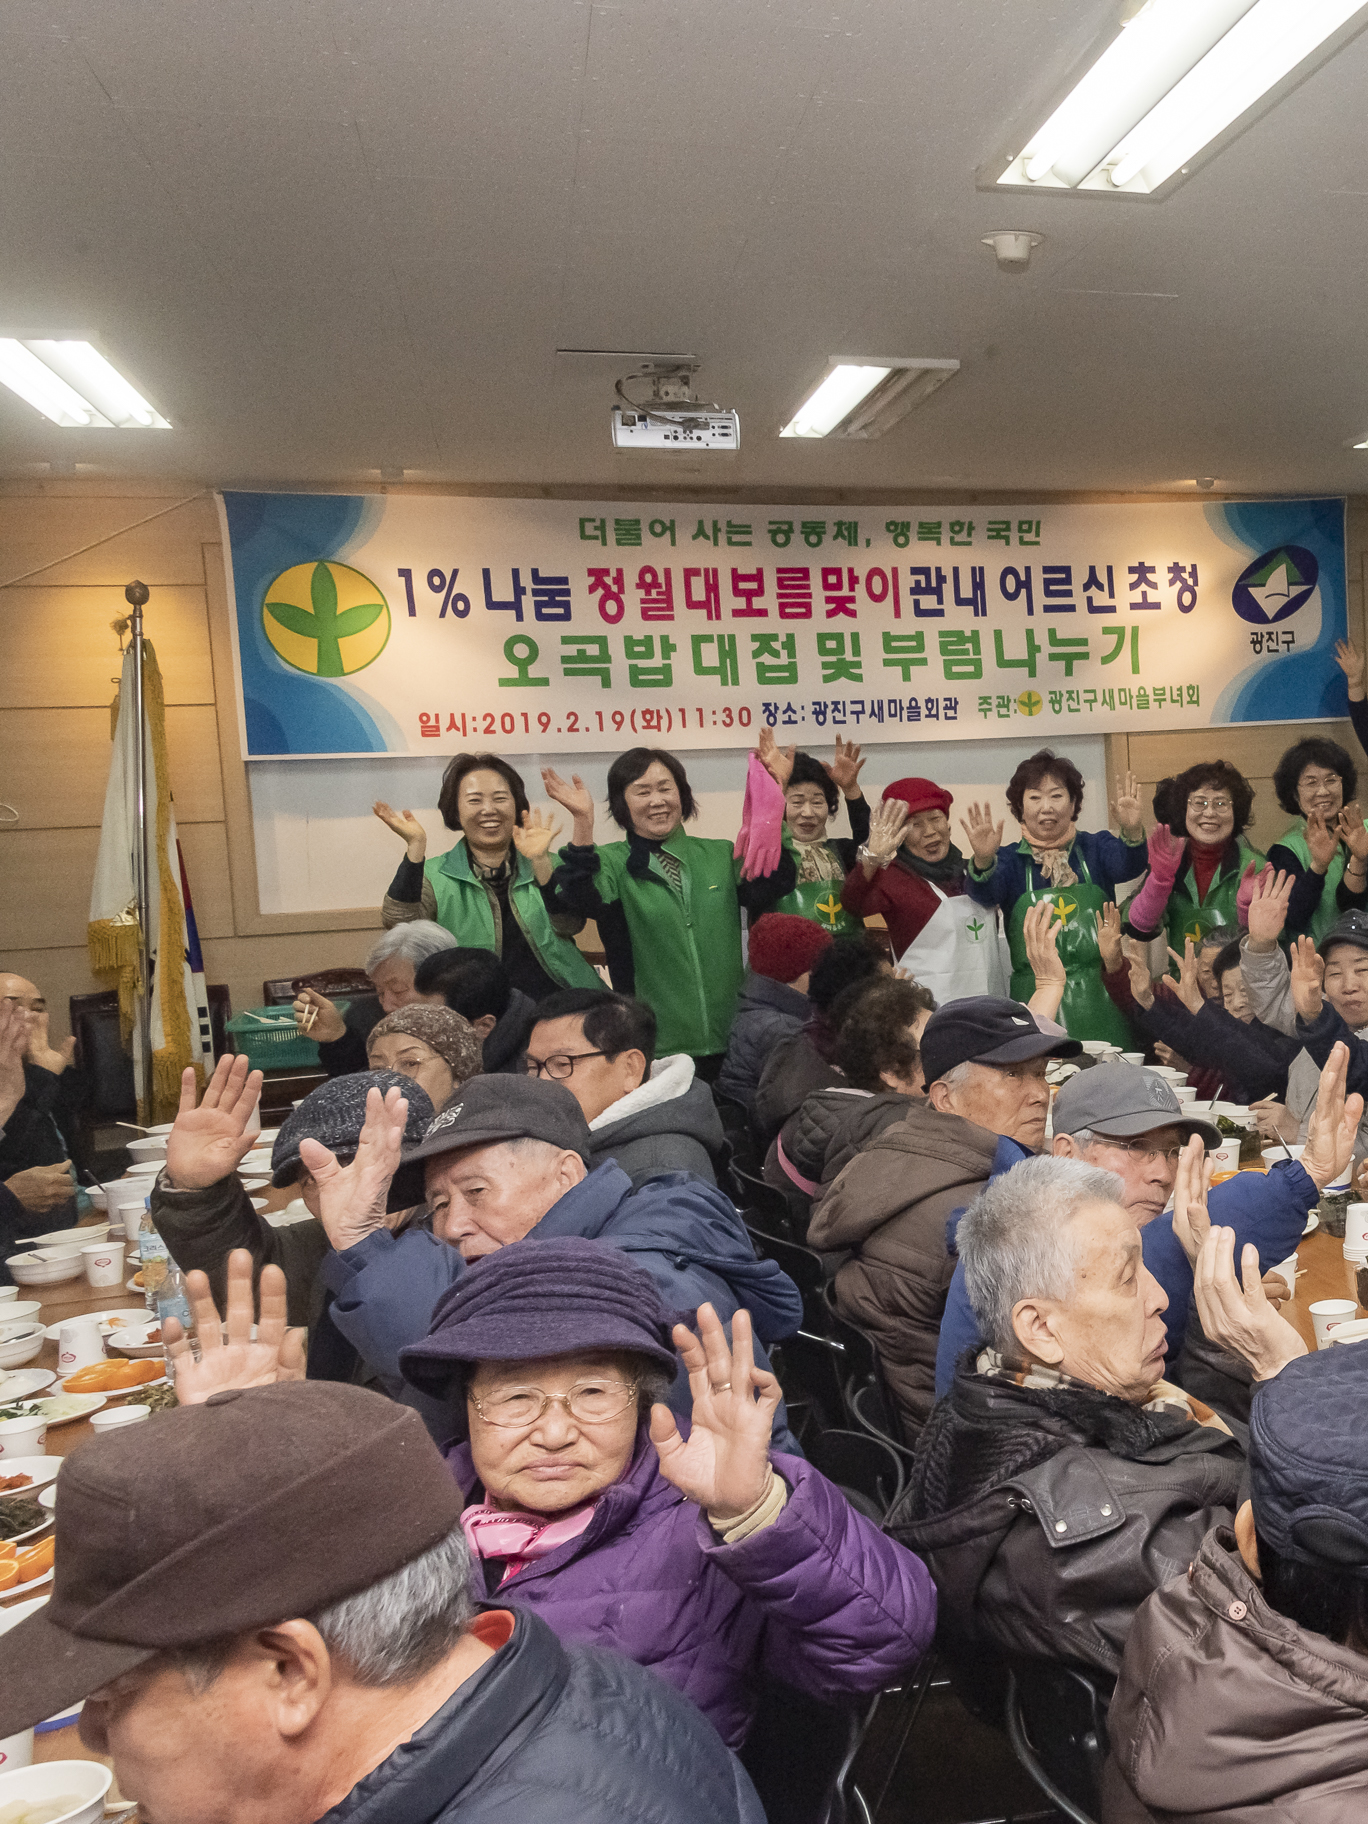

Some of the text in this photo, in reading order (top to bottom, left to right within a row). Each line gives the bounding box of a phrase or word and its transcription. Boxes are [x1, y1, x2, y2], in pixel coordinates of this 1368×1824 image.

[580, 517, 1041, 549] 더불어 사는 공동체, 행복한 국민
[481, 567, 572, 622] 나눔
[586, 564, 901, 625] 정월대보름맞이
[816, 631, 864, 684] 및
[1249, 630, 1296, 655] 광진구
[1048, 684, 1200, 715] 광진구새마을부녀회
